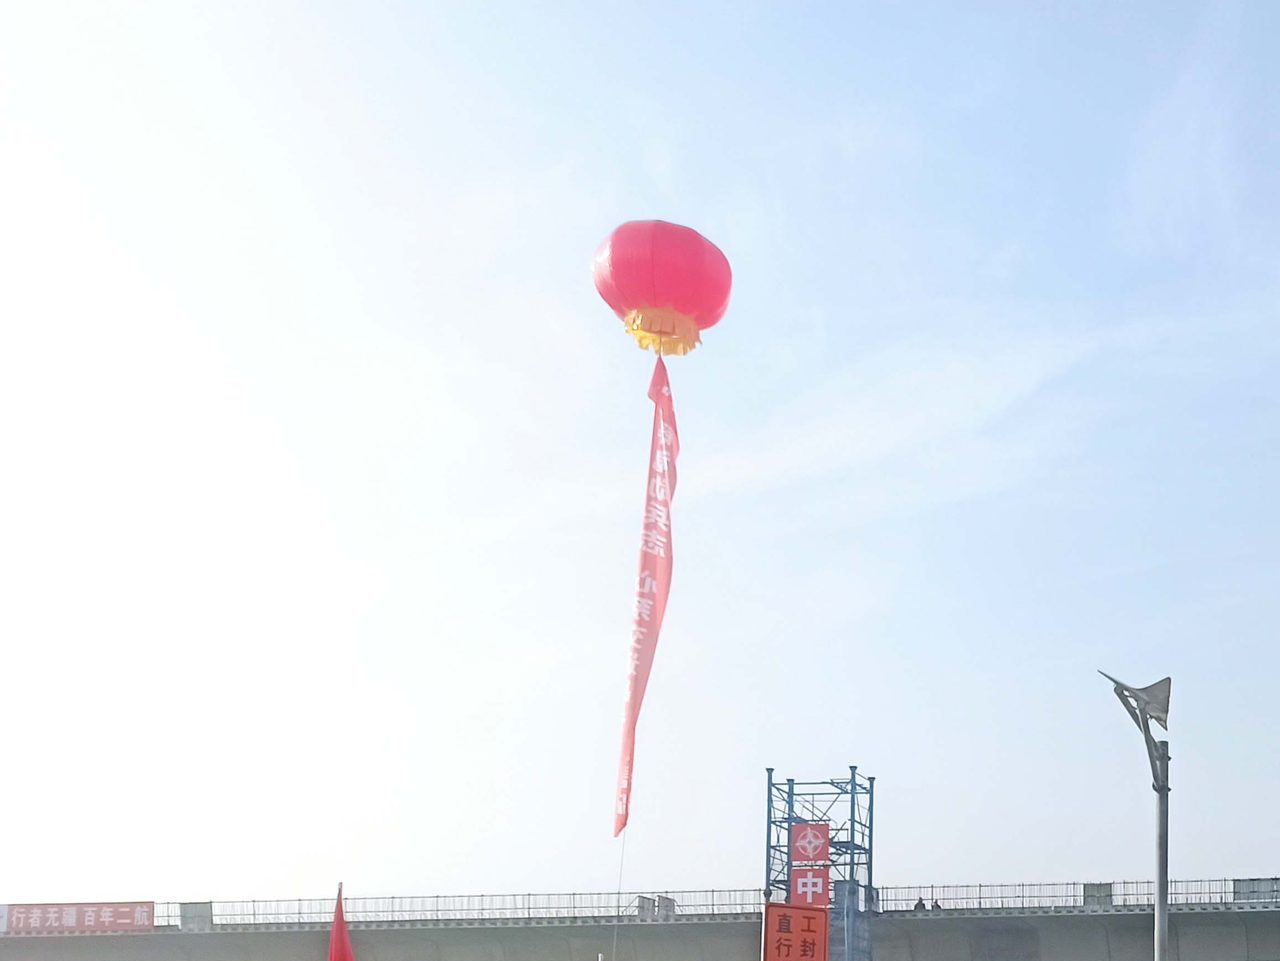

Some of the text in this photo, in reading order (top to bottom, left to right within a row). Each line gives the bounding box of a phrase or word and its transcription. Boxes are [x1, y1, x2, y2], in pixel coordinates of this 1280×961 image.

[11, 906, 150, 928] 行者无疆 百年二航
